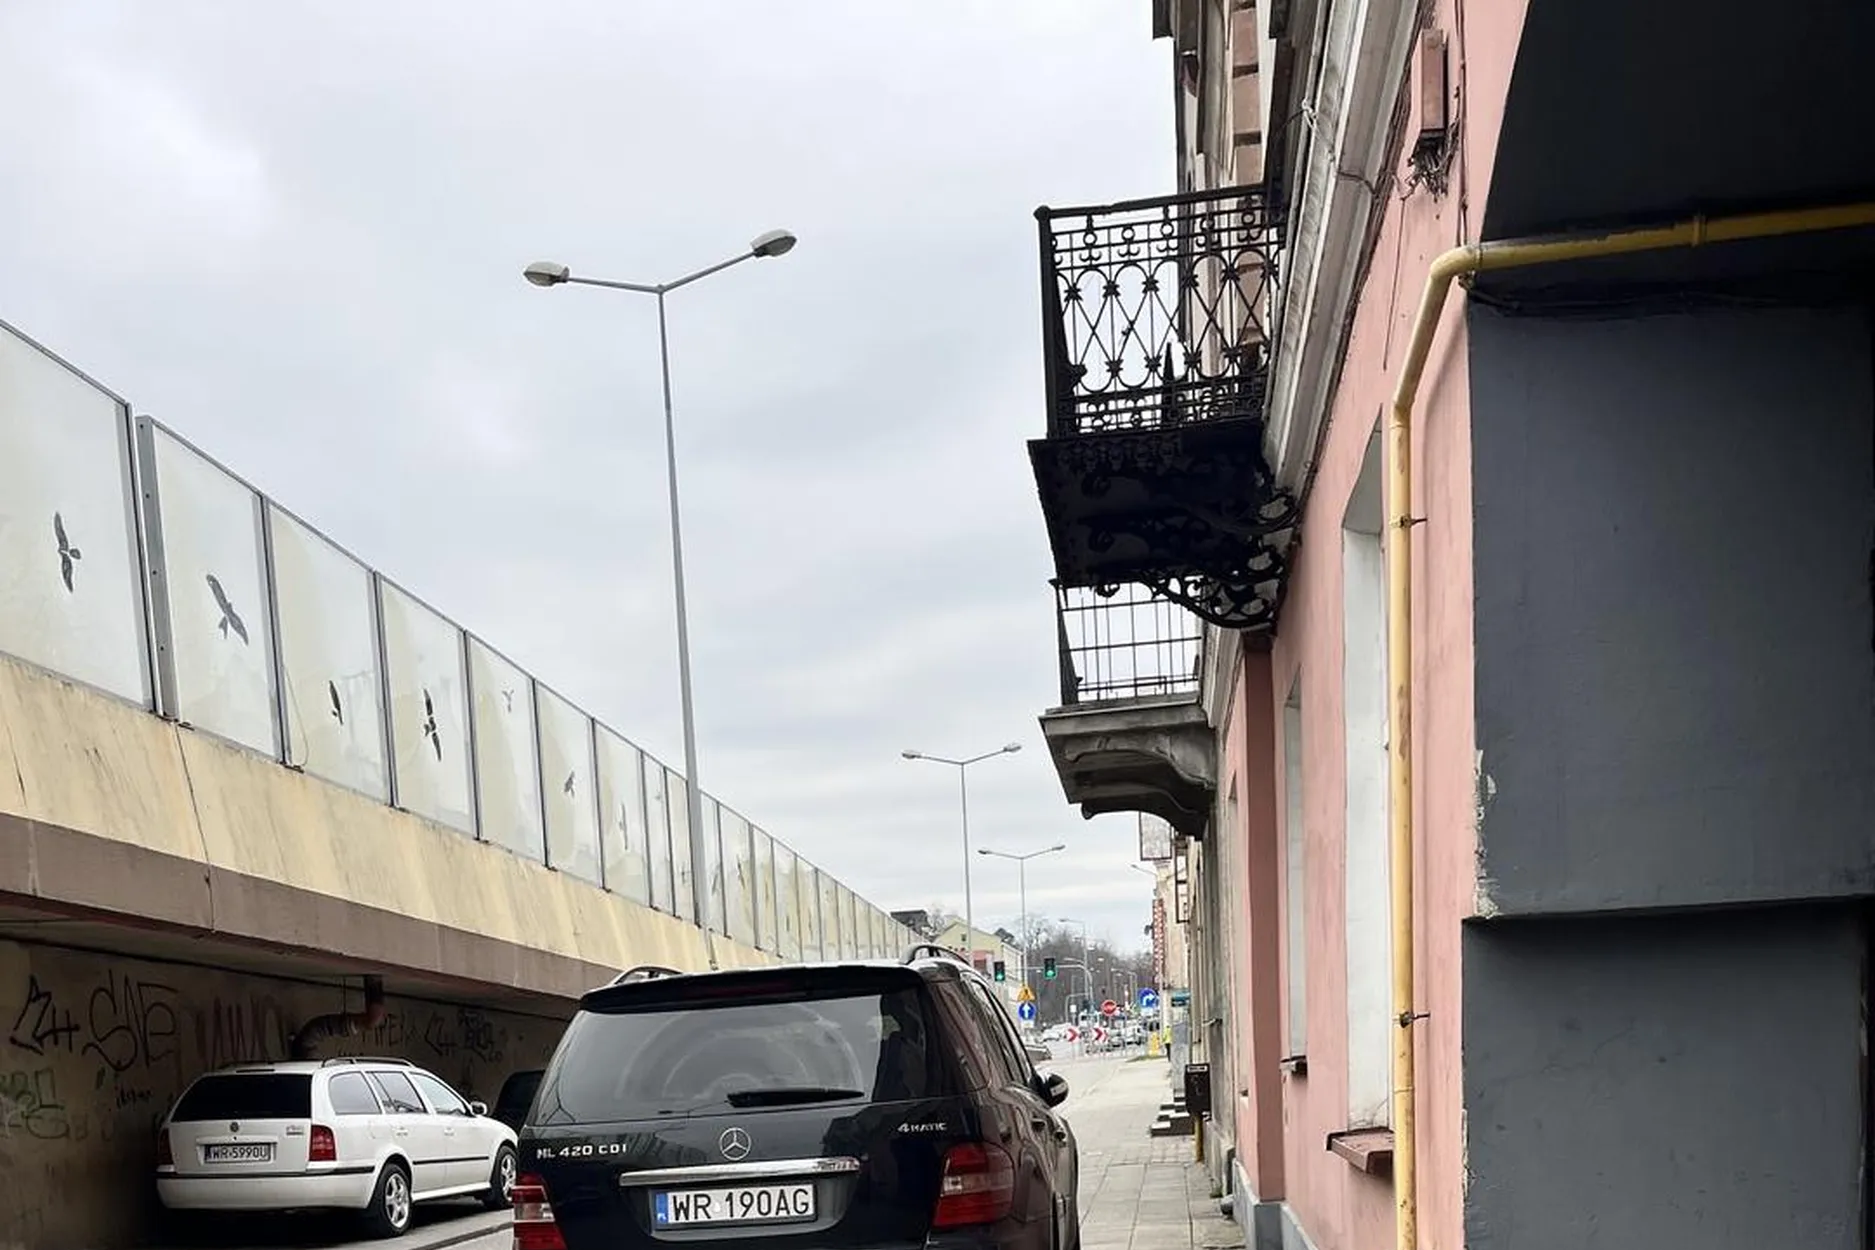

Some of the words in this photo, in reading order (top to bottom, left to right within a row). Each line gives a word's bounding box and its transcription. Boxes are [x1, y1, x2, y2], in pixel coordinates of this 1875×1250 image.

[559, 1145, 593, 1158] 420
[598, 1143, 627, 1155] CDI
[672, 1193, 712, 1222] WR
[725, 1188, 810, 1218] 190AG
